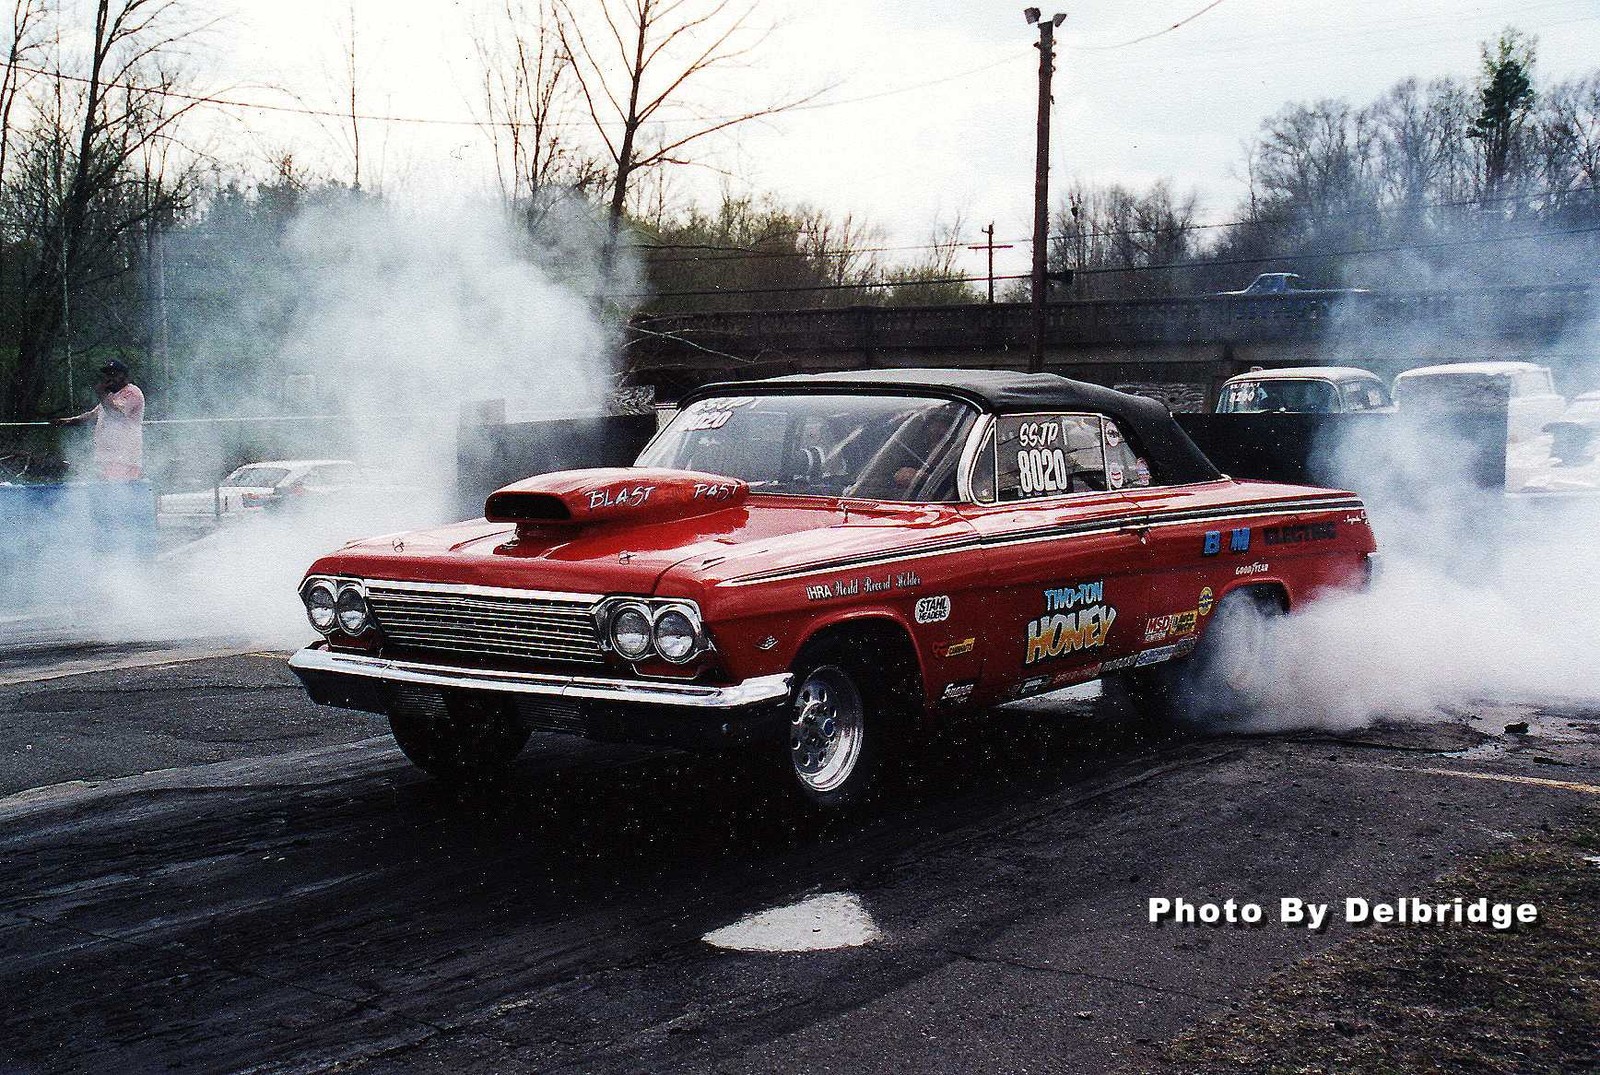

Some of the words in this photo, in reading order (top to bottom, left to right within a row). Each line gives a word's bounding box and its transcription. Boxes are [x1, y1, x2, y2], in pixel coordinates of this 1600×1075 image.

[1017, 448, 1067, 493] 8020
[585, 486, 656, 509] BLAST
[694, 483, 740, 500] PAST
[1203, 530, 1220, 555] B
[1230, 528, 1250, 552] M
[1235, 561, 1269, 575] GOODYEAR
[805, 585, 832, 600] IHRA
[863, 574, 891, 593] Record
[919, 597, 947, 612] STAHL
[919, 610, 947, 621] HEADERS
[1026, 604, 1117, 664] HONEY
[1145, 615, 1173, 635] MSD
